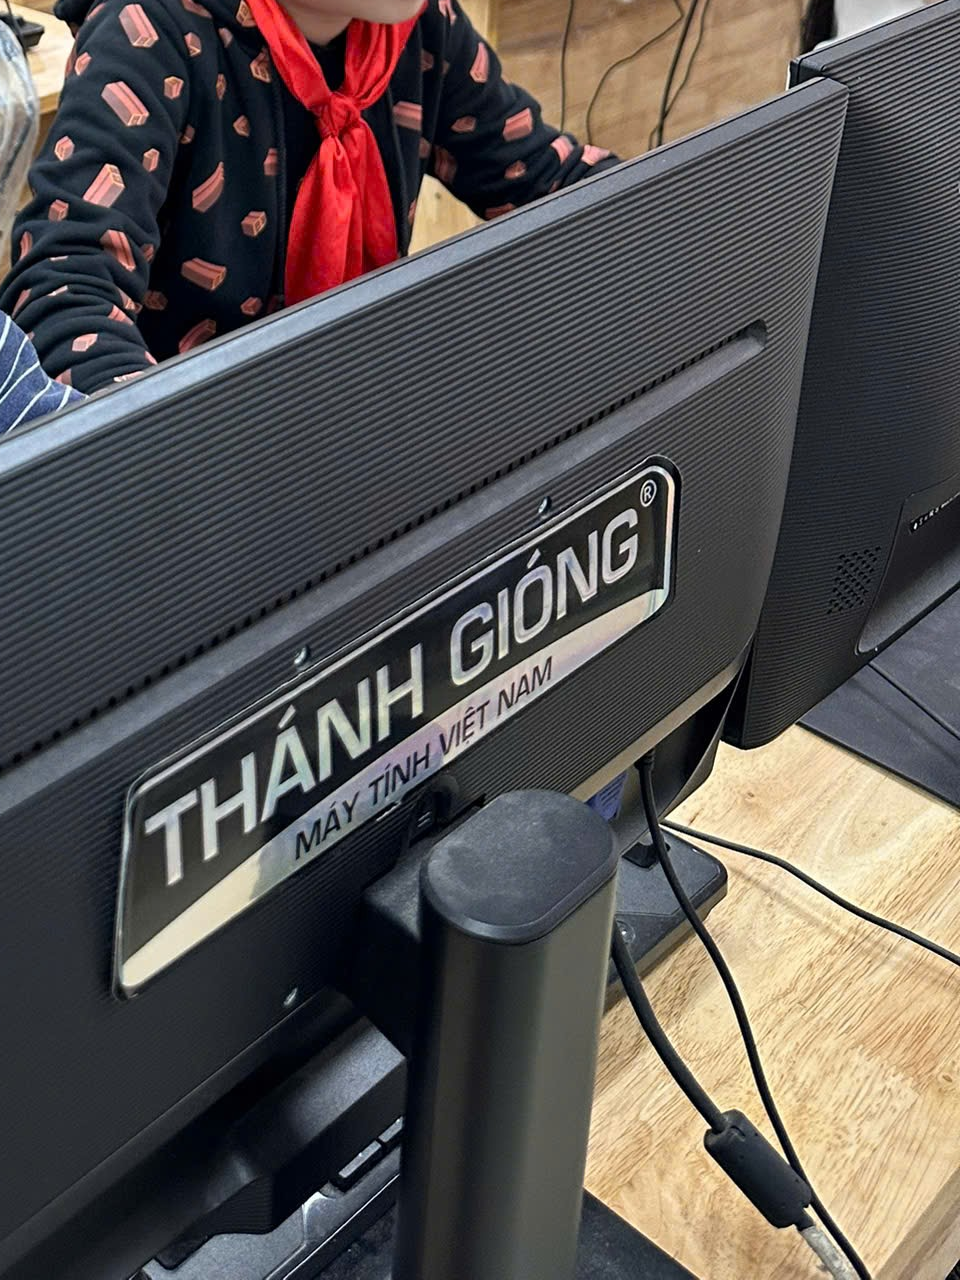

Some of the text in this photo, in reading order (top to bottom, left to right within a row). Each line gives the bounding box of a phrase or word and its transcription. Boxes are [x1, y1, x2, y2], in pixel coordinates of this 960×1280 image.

[145, 642, 423, 886] THÁNH
[295, 656, 553, 860] MÁY TÍNH VIỆT NAM
